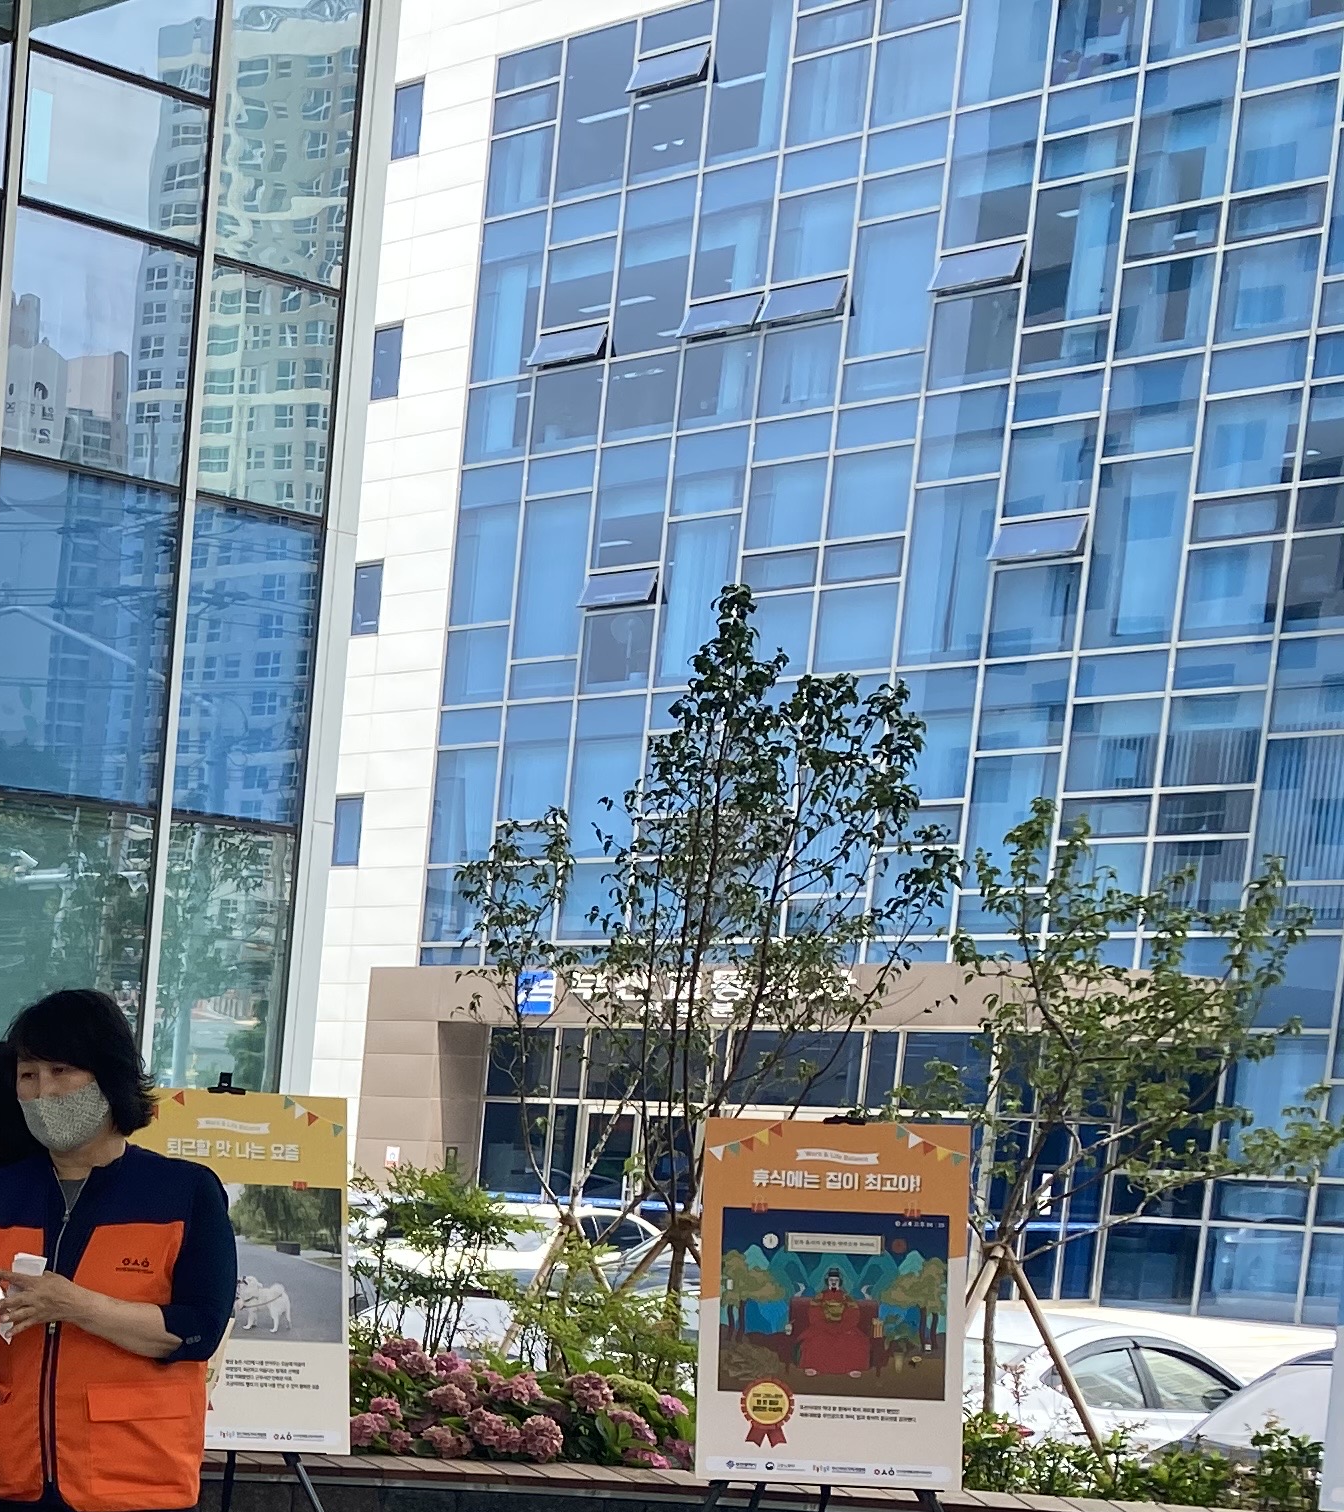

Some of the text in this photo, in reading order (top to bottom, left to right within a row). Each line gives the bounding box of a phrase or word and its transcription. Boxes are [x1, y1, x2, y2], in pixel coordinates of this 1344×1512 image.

[167, 1138, 299, 1162] 퇴근할 맛 나는 요즘
[753, 1169, 921, 1193] 휴식에는 집이 최고야!
